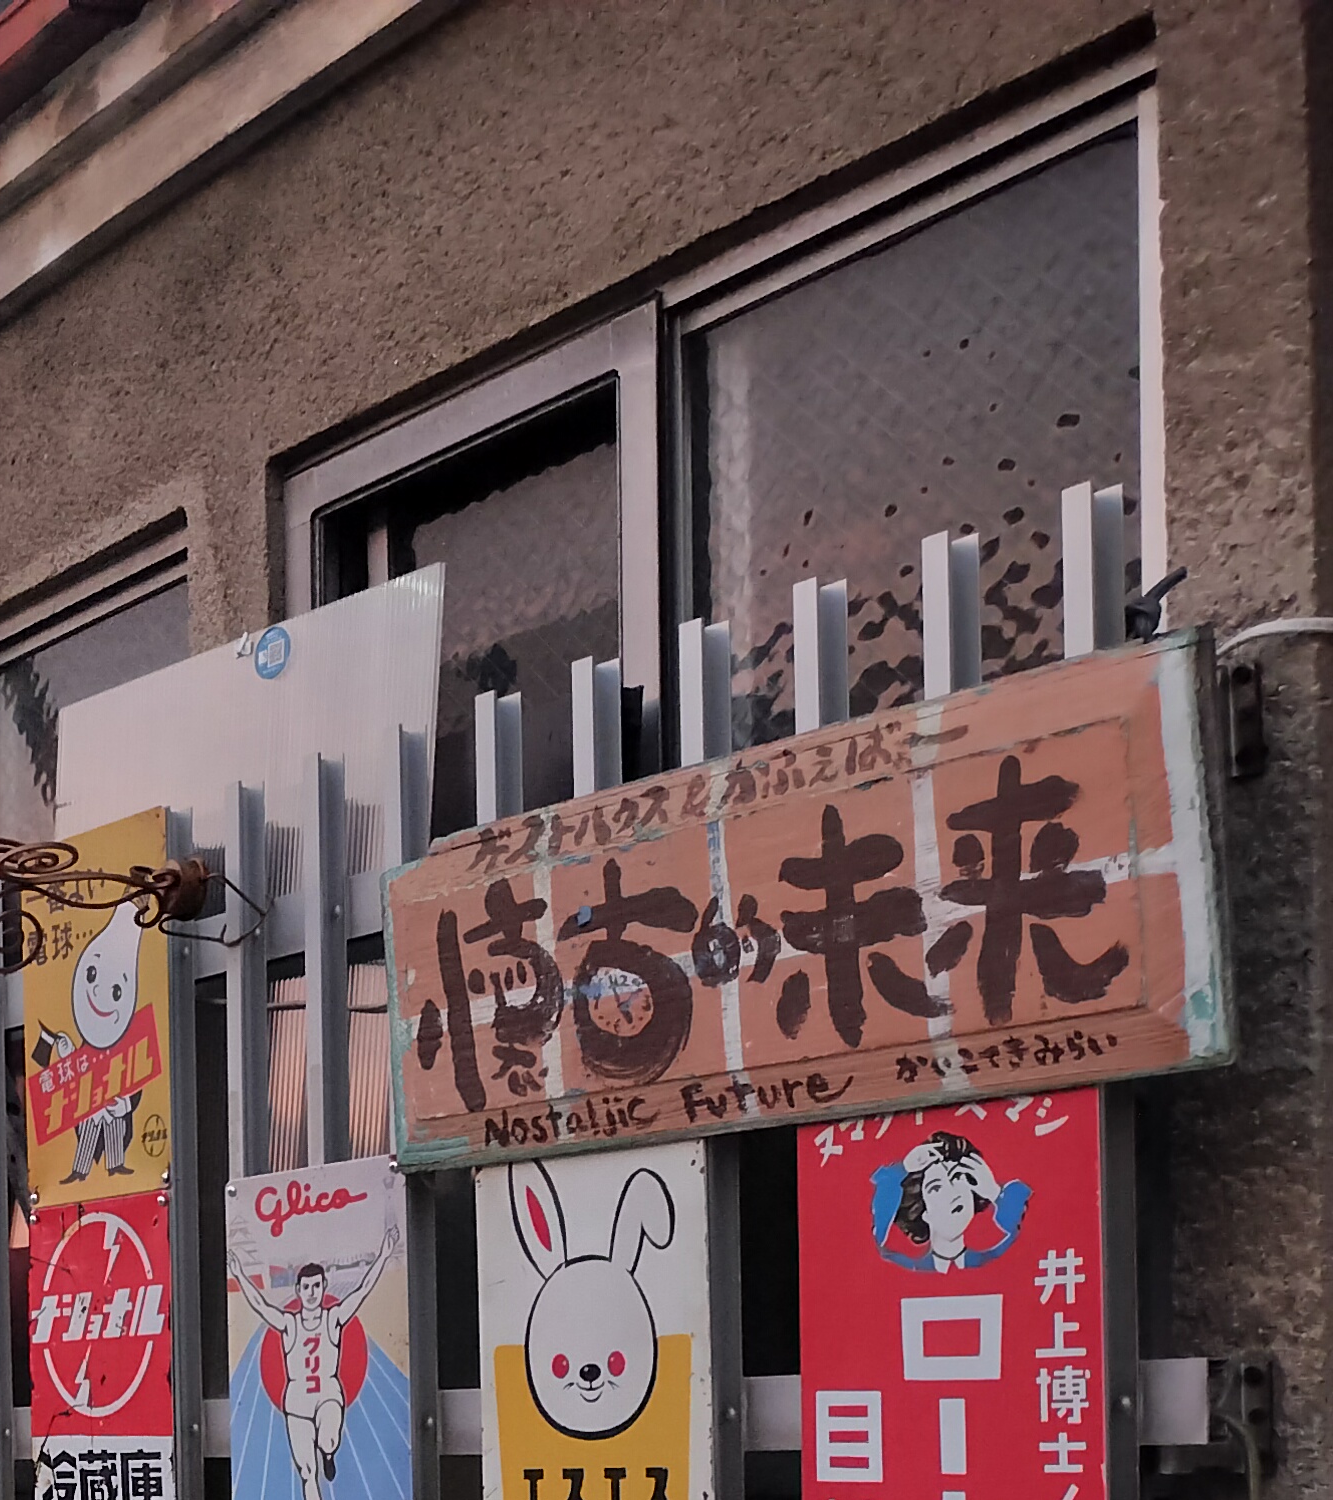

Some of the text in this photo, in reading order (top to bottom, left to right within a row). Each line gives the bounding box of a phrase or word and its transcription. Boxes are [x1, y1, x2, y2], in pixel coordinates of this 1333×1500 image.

[44, 1036, 153, 1136] ナショナル
[680, 1071, 854, 1125] Future
[254, 1180, 368, 1237] Glico
[31, 1284, 166, 1344] ナショナル
[302, 1334, 322, 1394] グリコ
